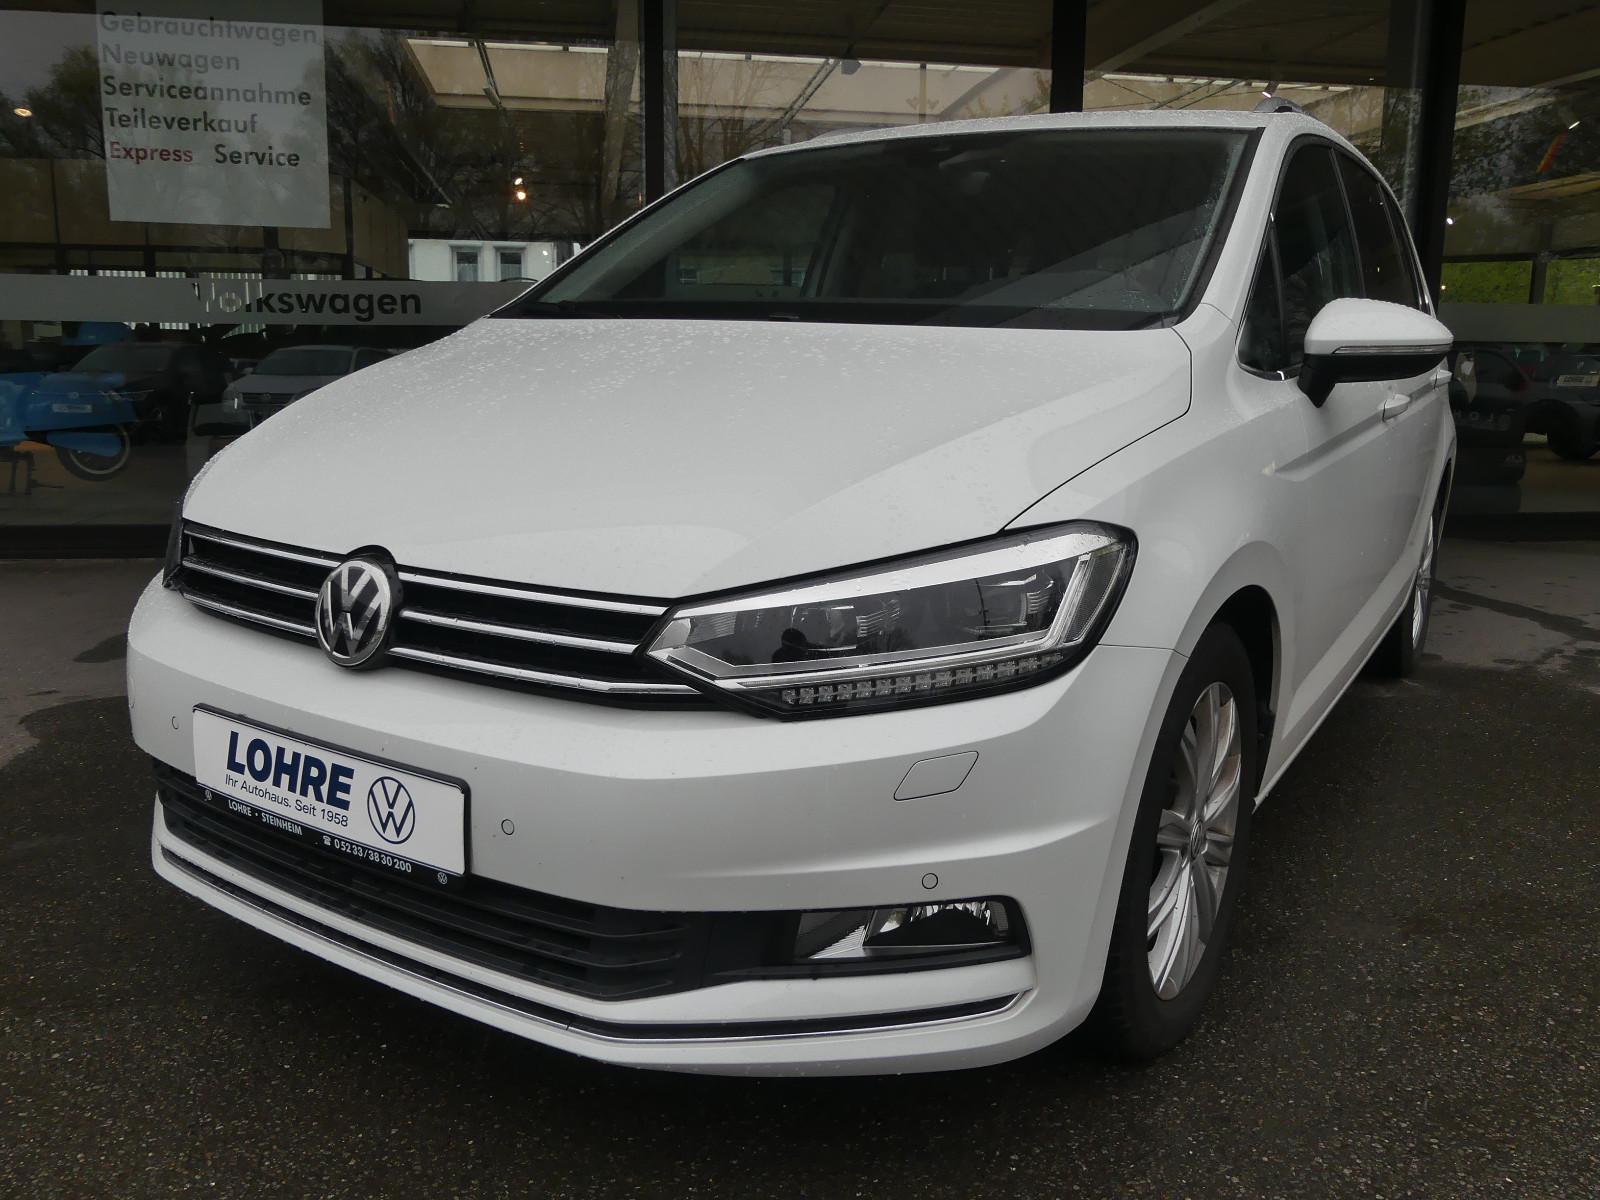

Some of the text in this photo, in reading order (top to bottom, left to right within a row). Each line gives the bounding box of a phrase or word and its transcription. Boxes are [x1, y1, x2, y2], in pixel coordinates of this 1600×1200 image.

[100, 11, 318, 47] Gebrauchtwagen
[101, 43, 241, 74] Neuwagen
[103, 75, 312, 107] Serviceannahme
[105, 106, 259, 134] Teileverkauf
[110, 140, 301, 168] Express Service
[226, 730, 355, 812] LOHRE
[225, 773, 349, 827] Ihr Autohaus. Seit 1958
[228, 799, 303, 836] LOHRE STEINHEIM
